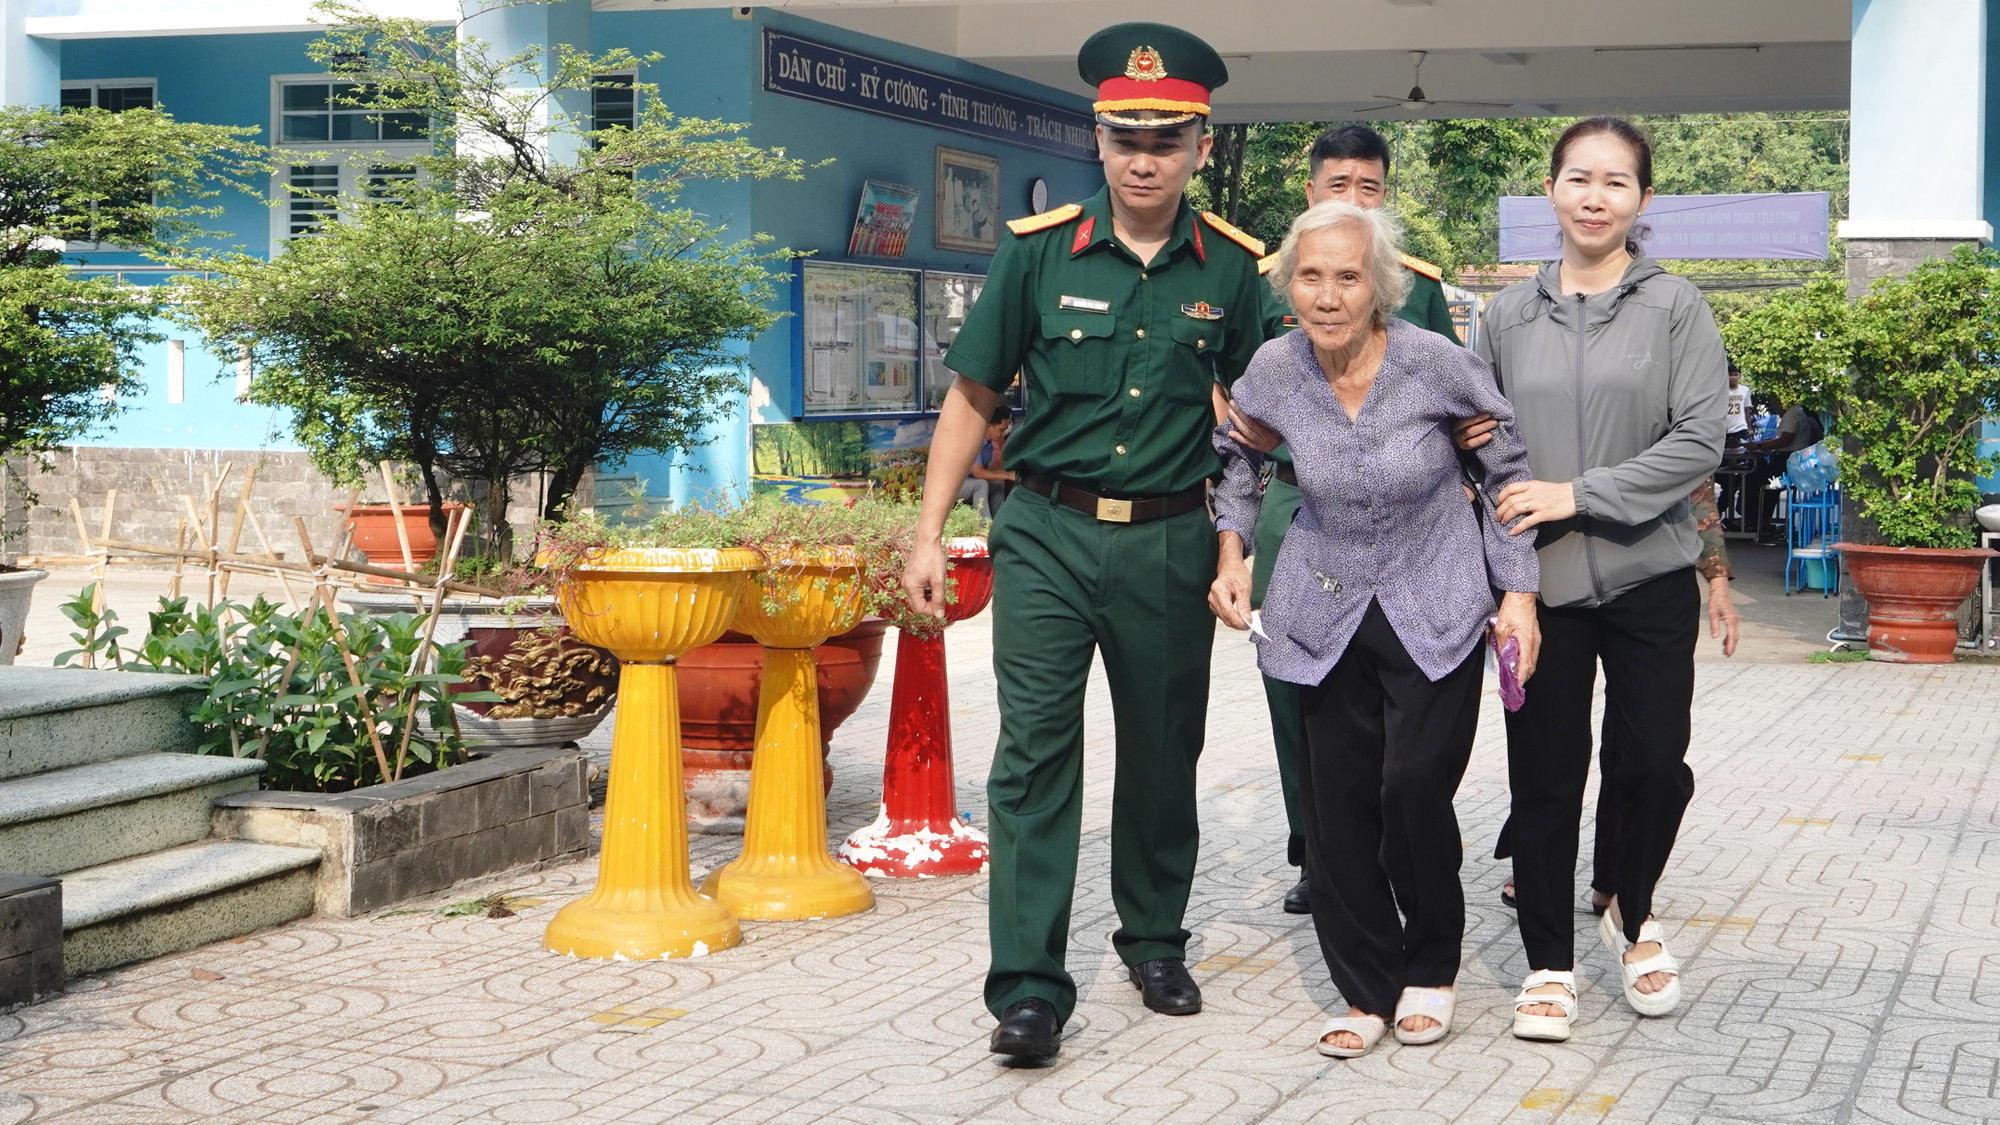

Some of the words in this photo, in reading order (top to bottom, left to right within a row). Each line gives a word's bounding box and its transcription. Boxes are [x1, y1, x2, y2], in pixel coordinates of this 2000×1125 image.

[778, 48, 812, 84] DÂN
[815, 58, 847, 92] CHỦ
[860, 66, 881, 99] KỶ
[884, 78, 928, 112] CƯƠNG
[939, 88, 969, 121] TÌNH
[971, 102, 1017, 132] THƯƠNG
[1026, 113, 1062, 143] TRÁCH
[1728, 403, 1741, 415] 23
